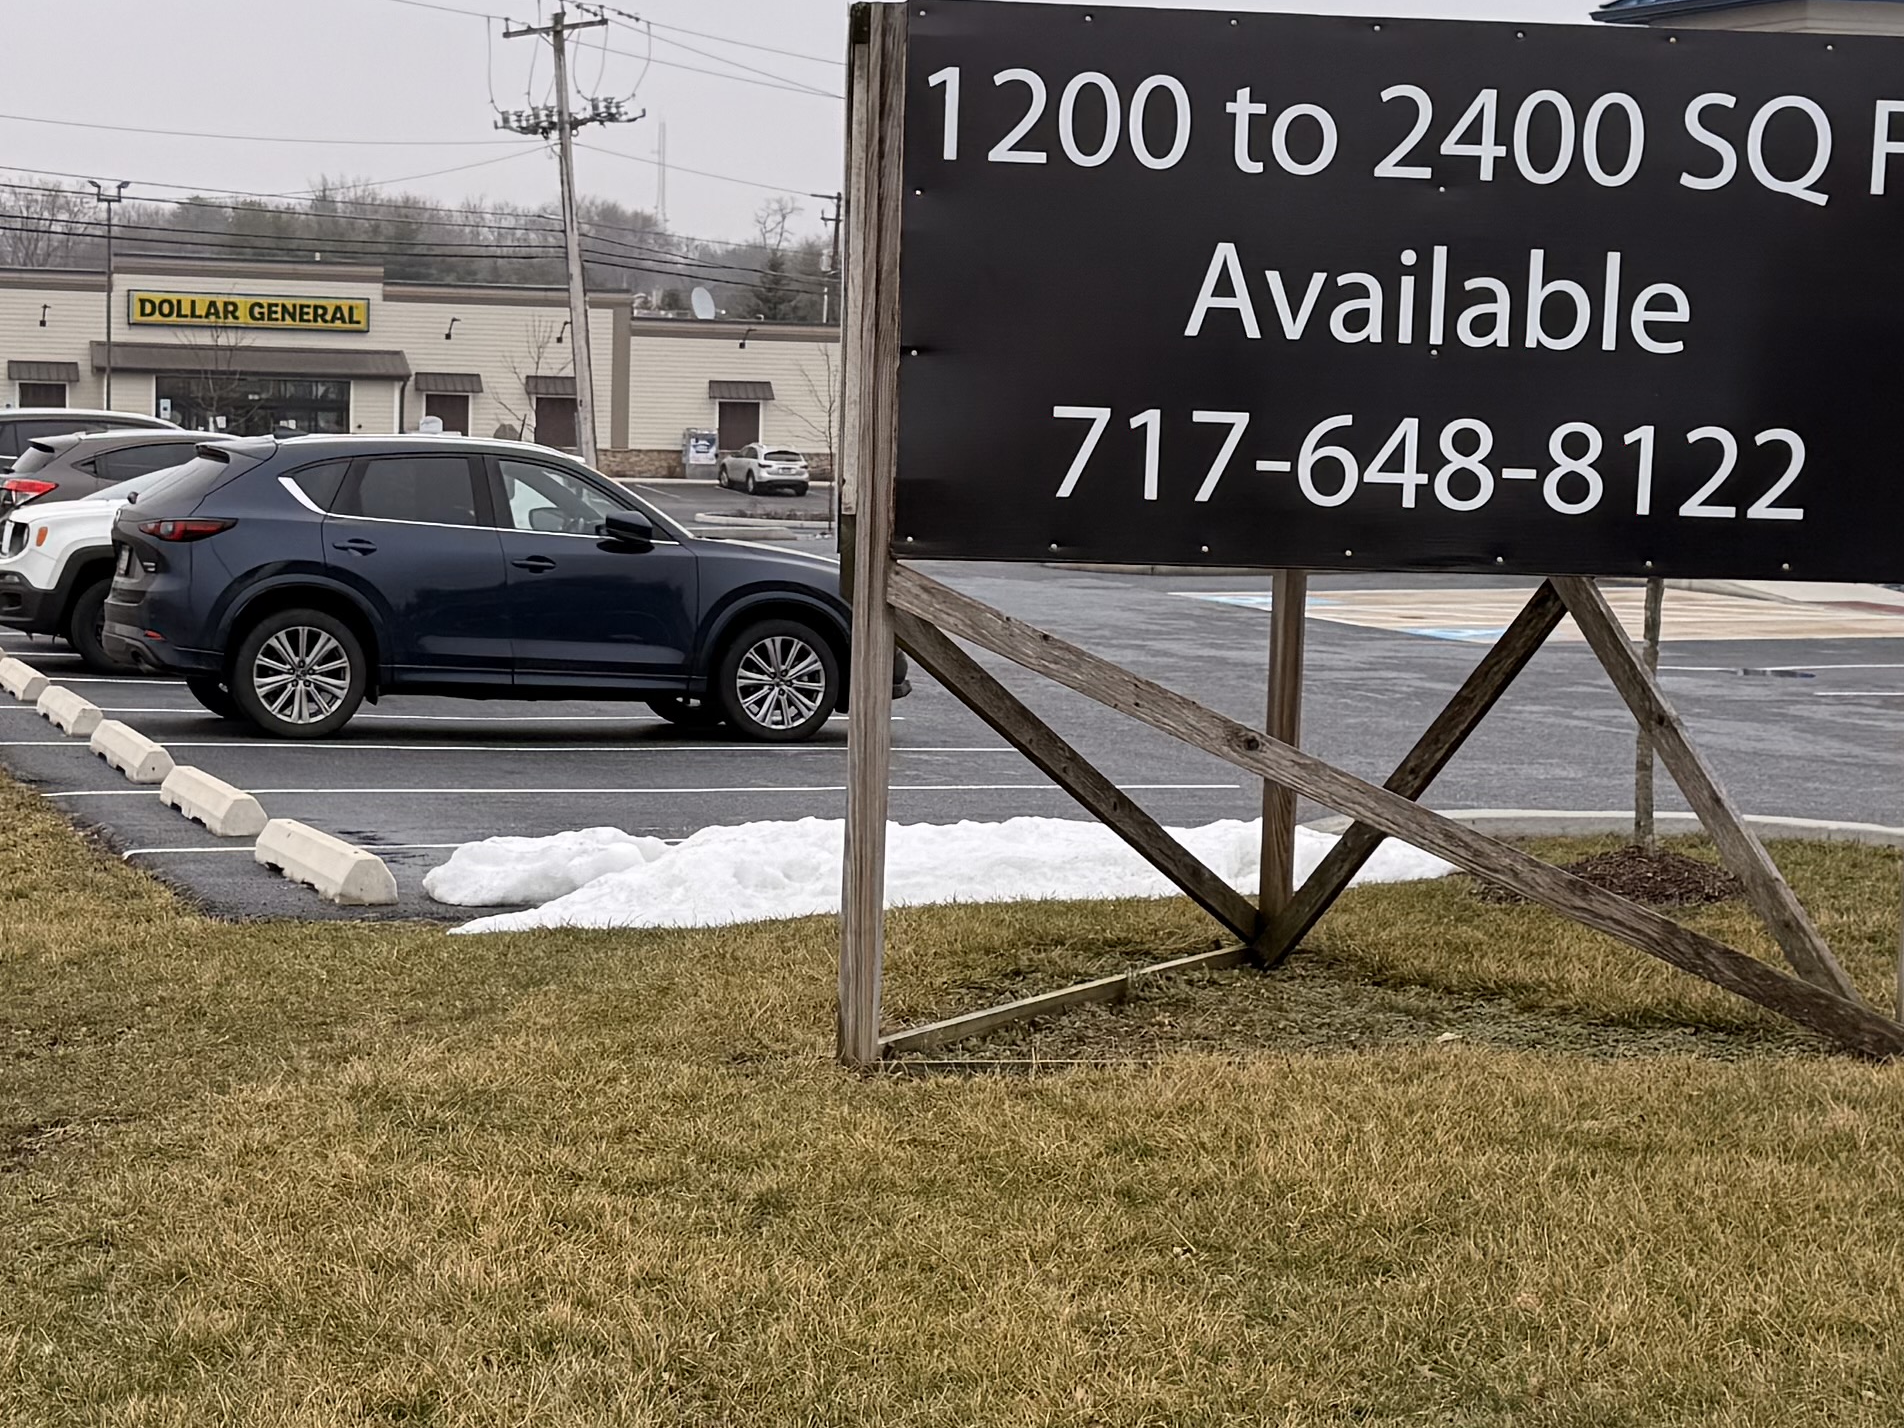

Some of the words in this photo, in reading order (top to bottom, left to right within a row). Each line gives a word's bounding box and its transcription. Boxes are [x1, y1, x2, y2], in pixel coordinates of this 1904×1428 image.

[927, 66, 1191, 170] 1200
[1225, 86, 1338, 176] to
[1373, 84, 1645, 190] 2400
[1679, 92, 1832, 206] SQ
[138, 297, 239, 321] DOLLAR
[248, 302, 362, 325] GENERAL
[1184, 242, 1690, 354] Available
[1053, 405, 1806, 520] 717-648-8122
